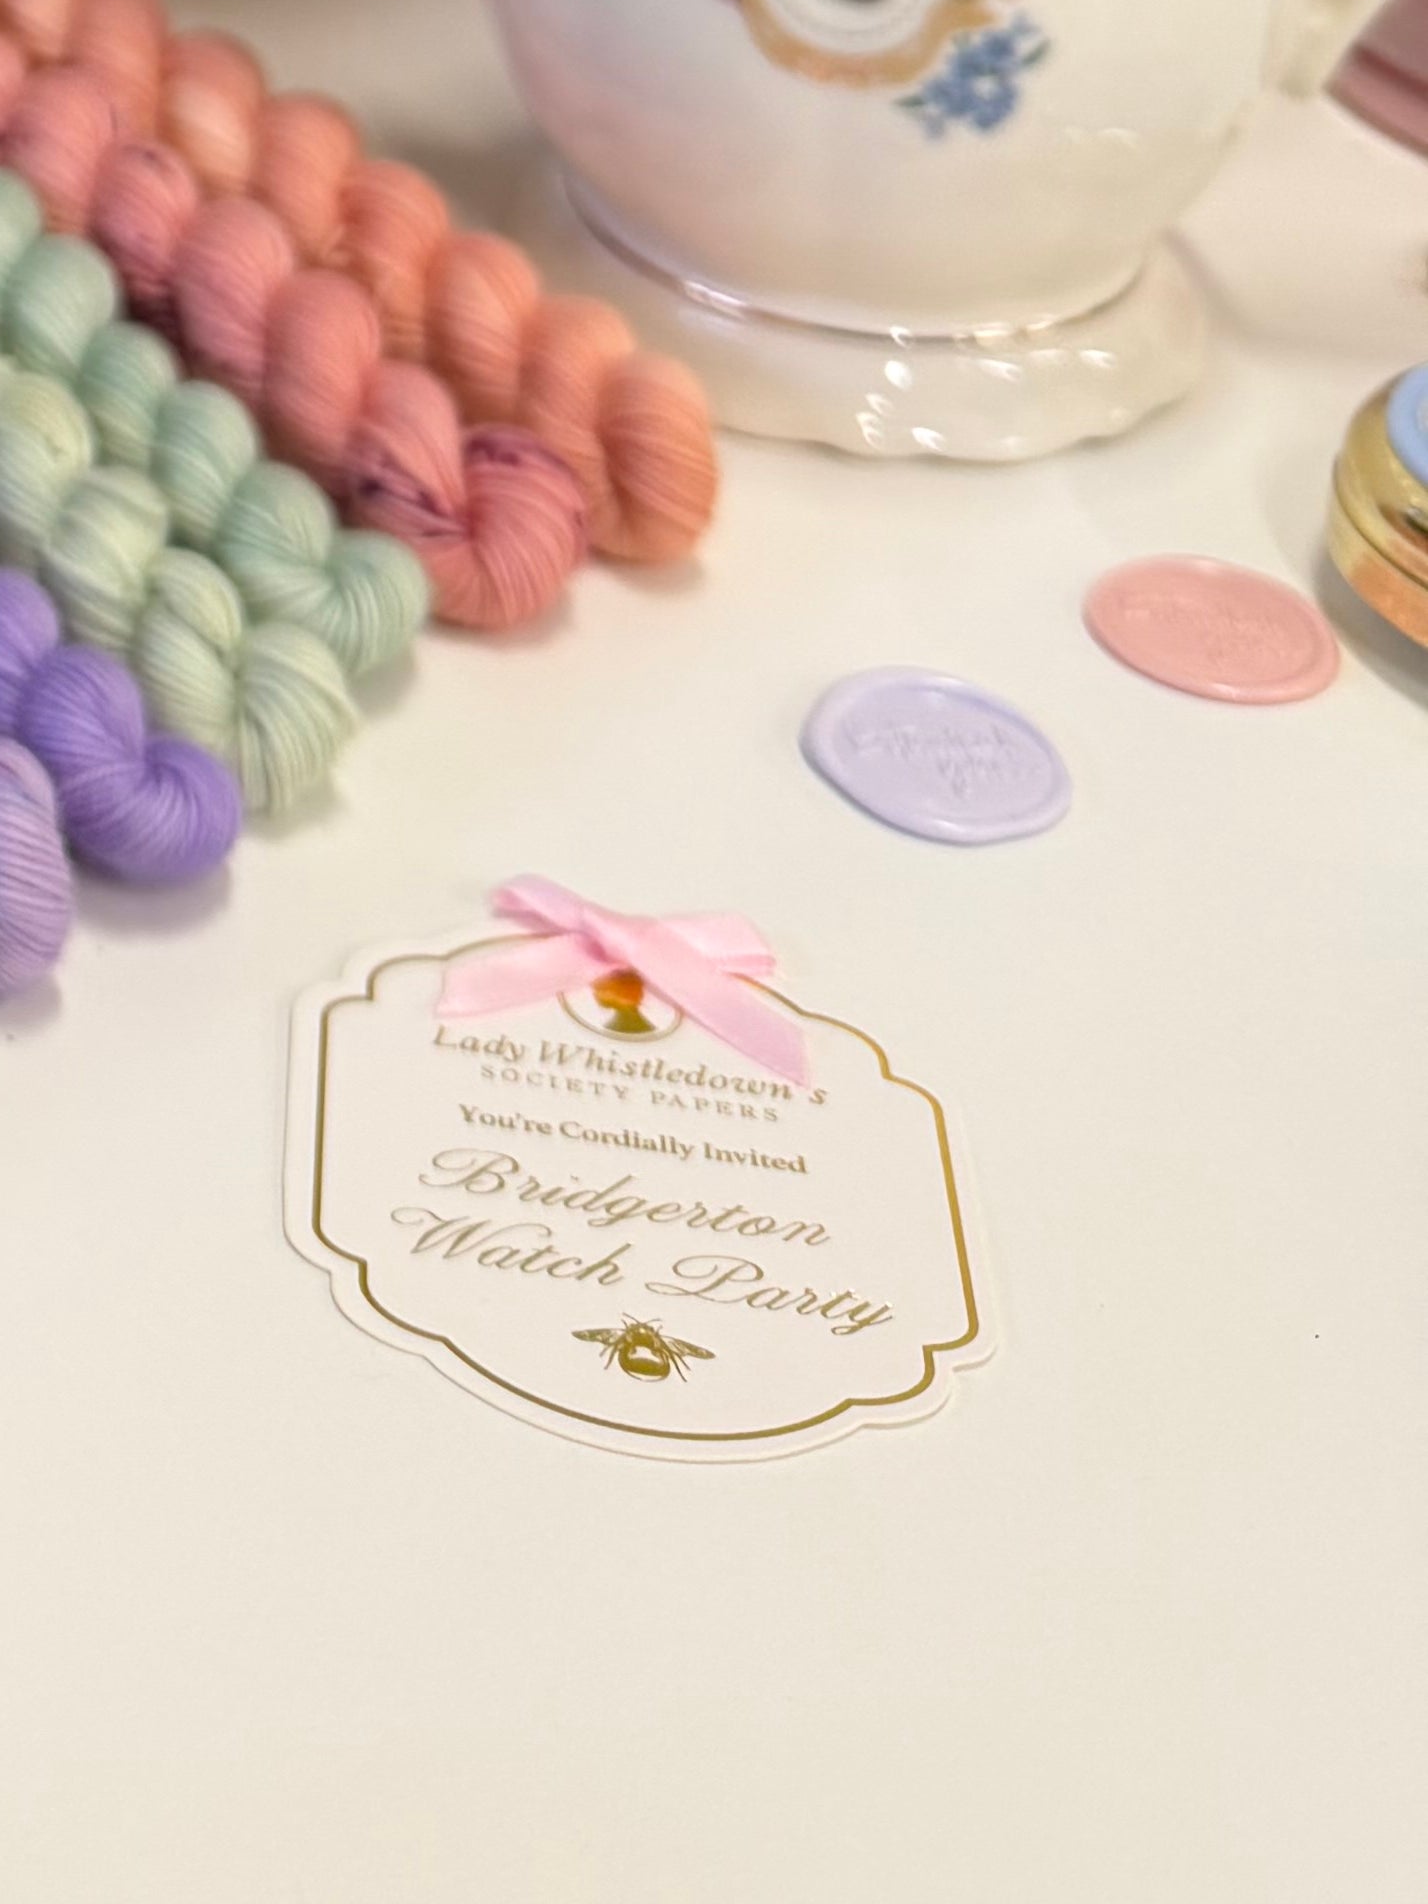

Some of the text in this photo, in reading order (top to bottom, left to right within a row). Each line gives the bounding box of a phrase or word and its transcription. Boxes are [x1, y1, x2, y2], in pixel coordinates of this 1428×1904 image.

[432, 1024, 829, 1106] Lady Whistledowns
[479, 1063, 781, 1123] SOCIETY PAPERS
[458, 1103, 808, 1175] You're Cordially Invited
[417, 1148, 831, 1248] Bridgerton
[390, 1206, 895, 1336] Watch Party
